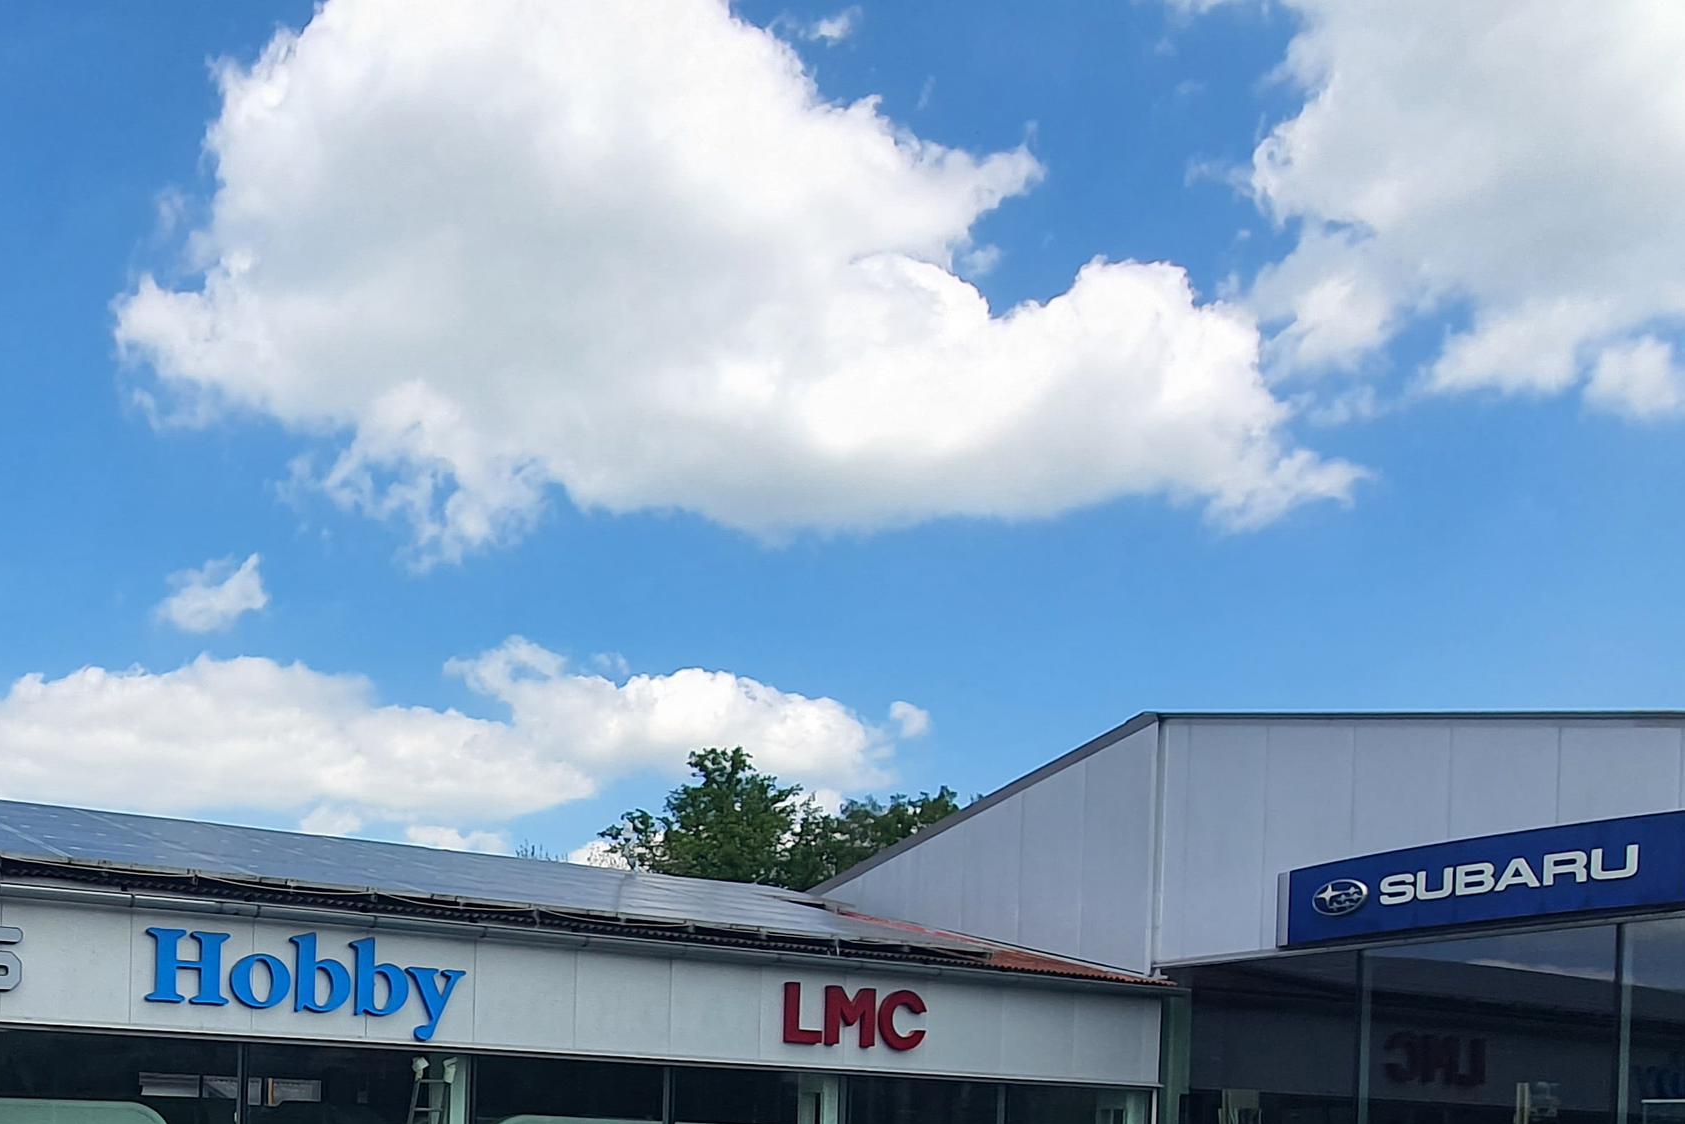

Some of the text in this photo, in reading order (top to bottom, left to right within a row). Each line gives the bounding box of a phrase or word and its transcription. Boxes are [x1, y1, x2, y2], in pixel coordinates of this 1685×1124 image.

[1379, 844, 1639, 905] SUBARU
[144, 926, 467, 1041] Hobby
[782, 981, 927, 1051] LMC
